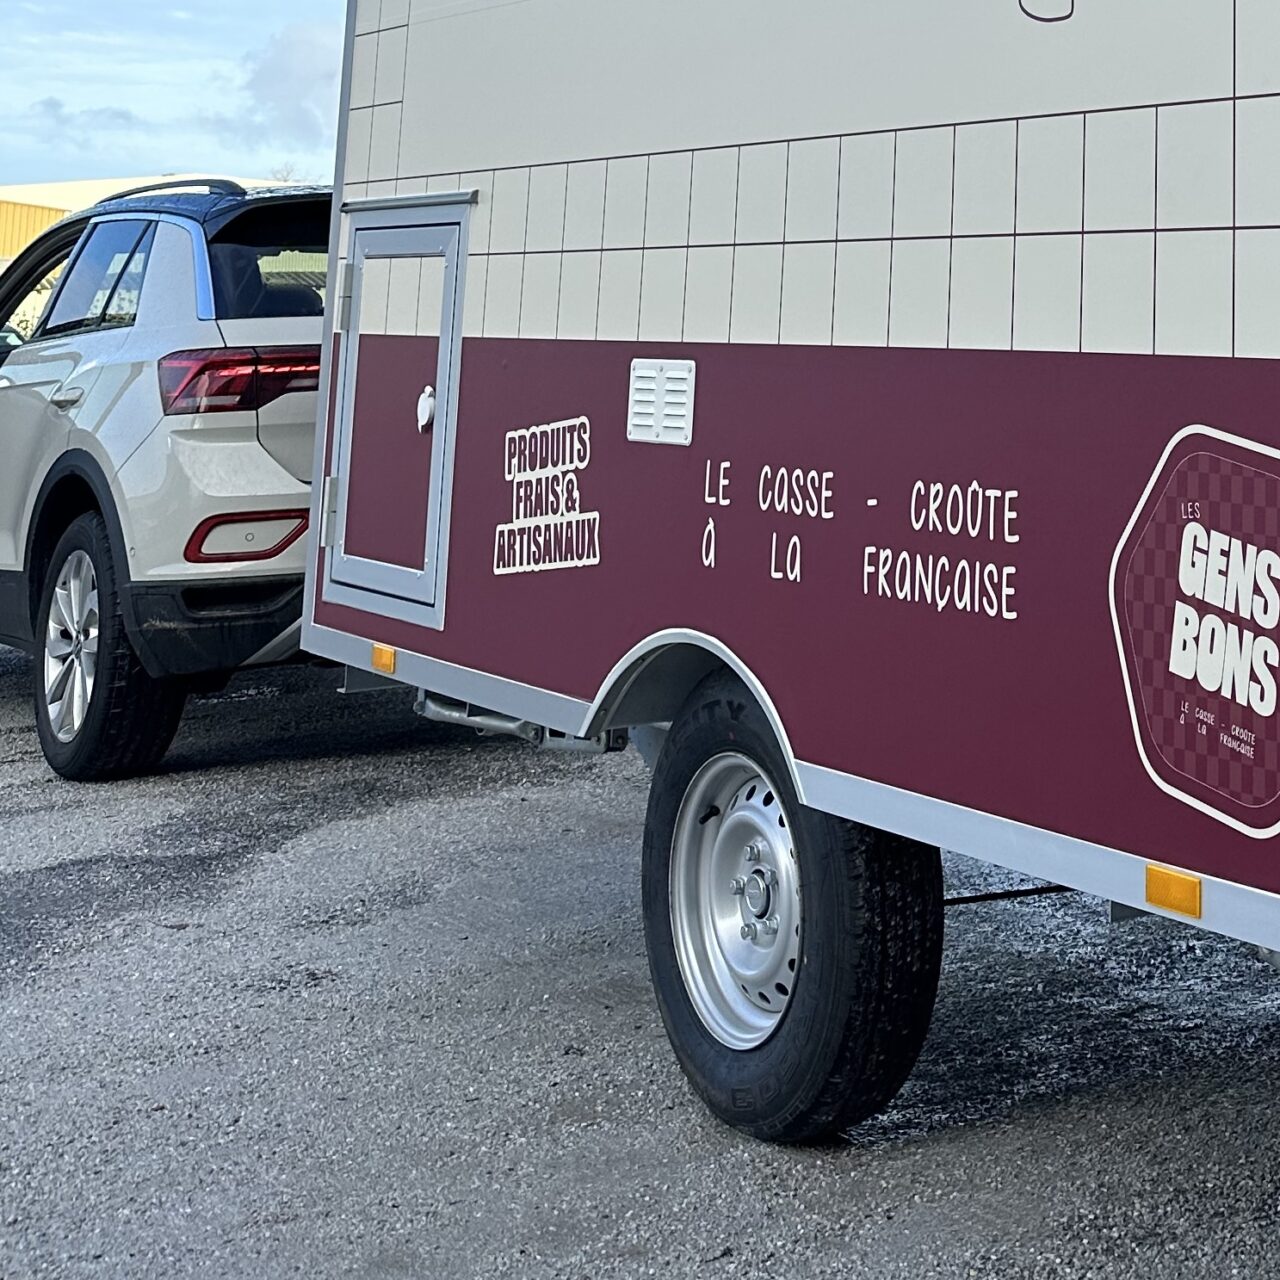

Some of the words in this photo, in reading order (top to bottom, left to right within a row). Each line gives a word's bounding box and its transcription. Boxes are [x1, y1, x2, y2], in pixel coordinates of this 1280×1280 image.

[507, 421, 588, 475] PRODUITS
[515, 473, 560, 520] FRAIS
[564, 477, 577, 514] &
[704, 459, 731, 506] LE
[910, 480, 1020, 543] CROÛTE
[1182, 503, 1200, 519] LES
[496, 517, 598, 569] ARTISANAUX
[1169, 600, 1280, 718] BONS
[1181, 700, 1190, 713] LE
